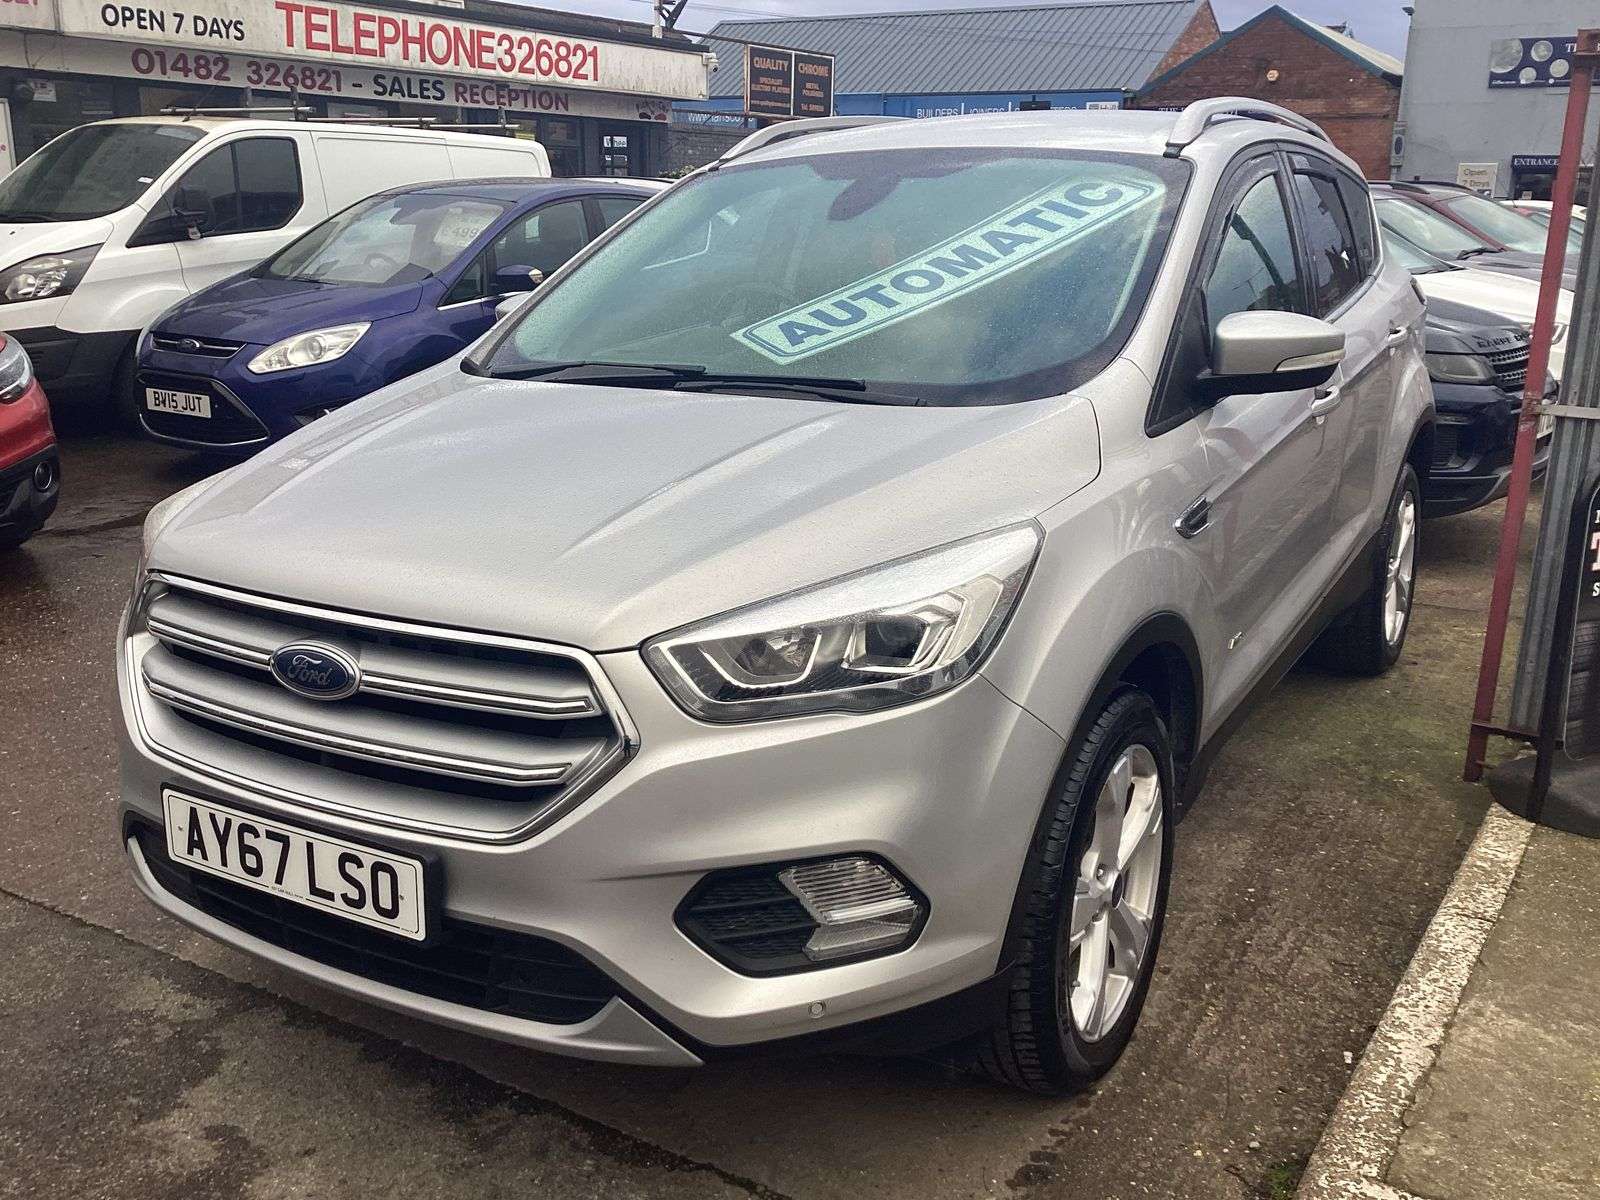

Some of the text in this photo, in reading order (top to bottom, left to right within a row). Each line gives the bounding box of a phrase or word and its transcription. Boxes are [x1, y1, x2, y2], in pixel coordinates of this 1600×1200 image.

[100, 3, 245, 41] OPEN 7 DAYS
[753, 57, 789, 71] QUALITY
[798, 62, 829, 76] CHROME
[131, 47, 231, 82] 01482
[246, 60, 342, 93] 326821
[373, 74, 446, 101] SALES
[454, 81, 569, 112] RECEPTION
[916, 108, 959, 118] BUILDERS
[1514, 158, 1559, 166] ENTRANCE
[1463, 168, 1487, 177] Open
[1470, 180, 1490, 188] Days
[777, 181, 1124, 348] AUTOMATIC
[182, 395, 203, 412] JUT
[286, 654, 333, 686] Ford
[186, 806, 400, 920] AY67 LSO
